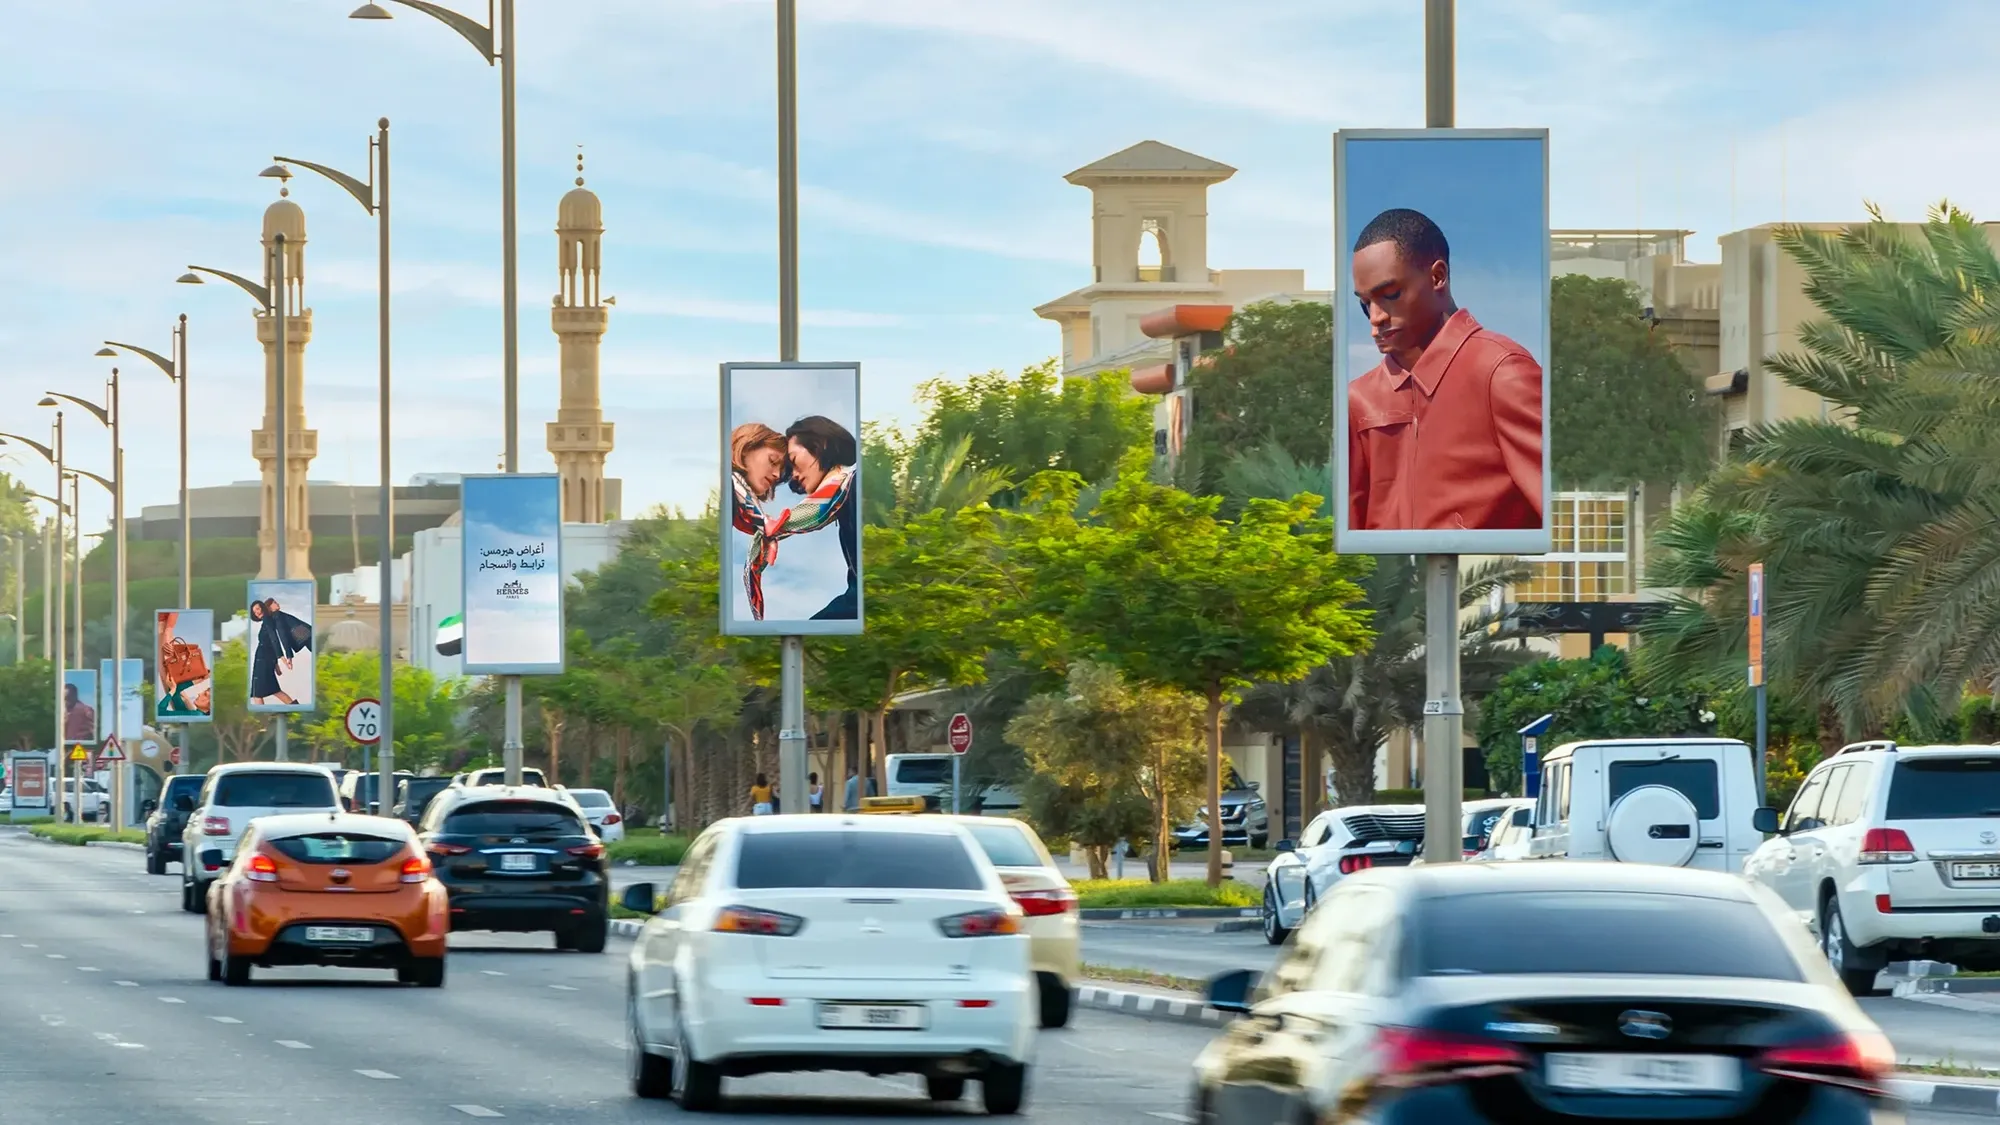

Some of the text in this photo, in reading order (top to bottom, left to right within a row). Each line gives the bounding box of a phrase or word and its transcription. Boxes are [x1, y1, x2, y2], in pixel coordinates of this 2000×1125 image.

[480, 542, 544, 557] أغراض هيرمس:
[479, 559, 545, 572] ترابط وانسجام
[359, 707, 376, 720] ٧٠
[356, 723, 377, 736] 70
